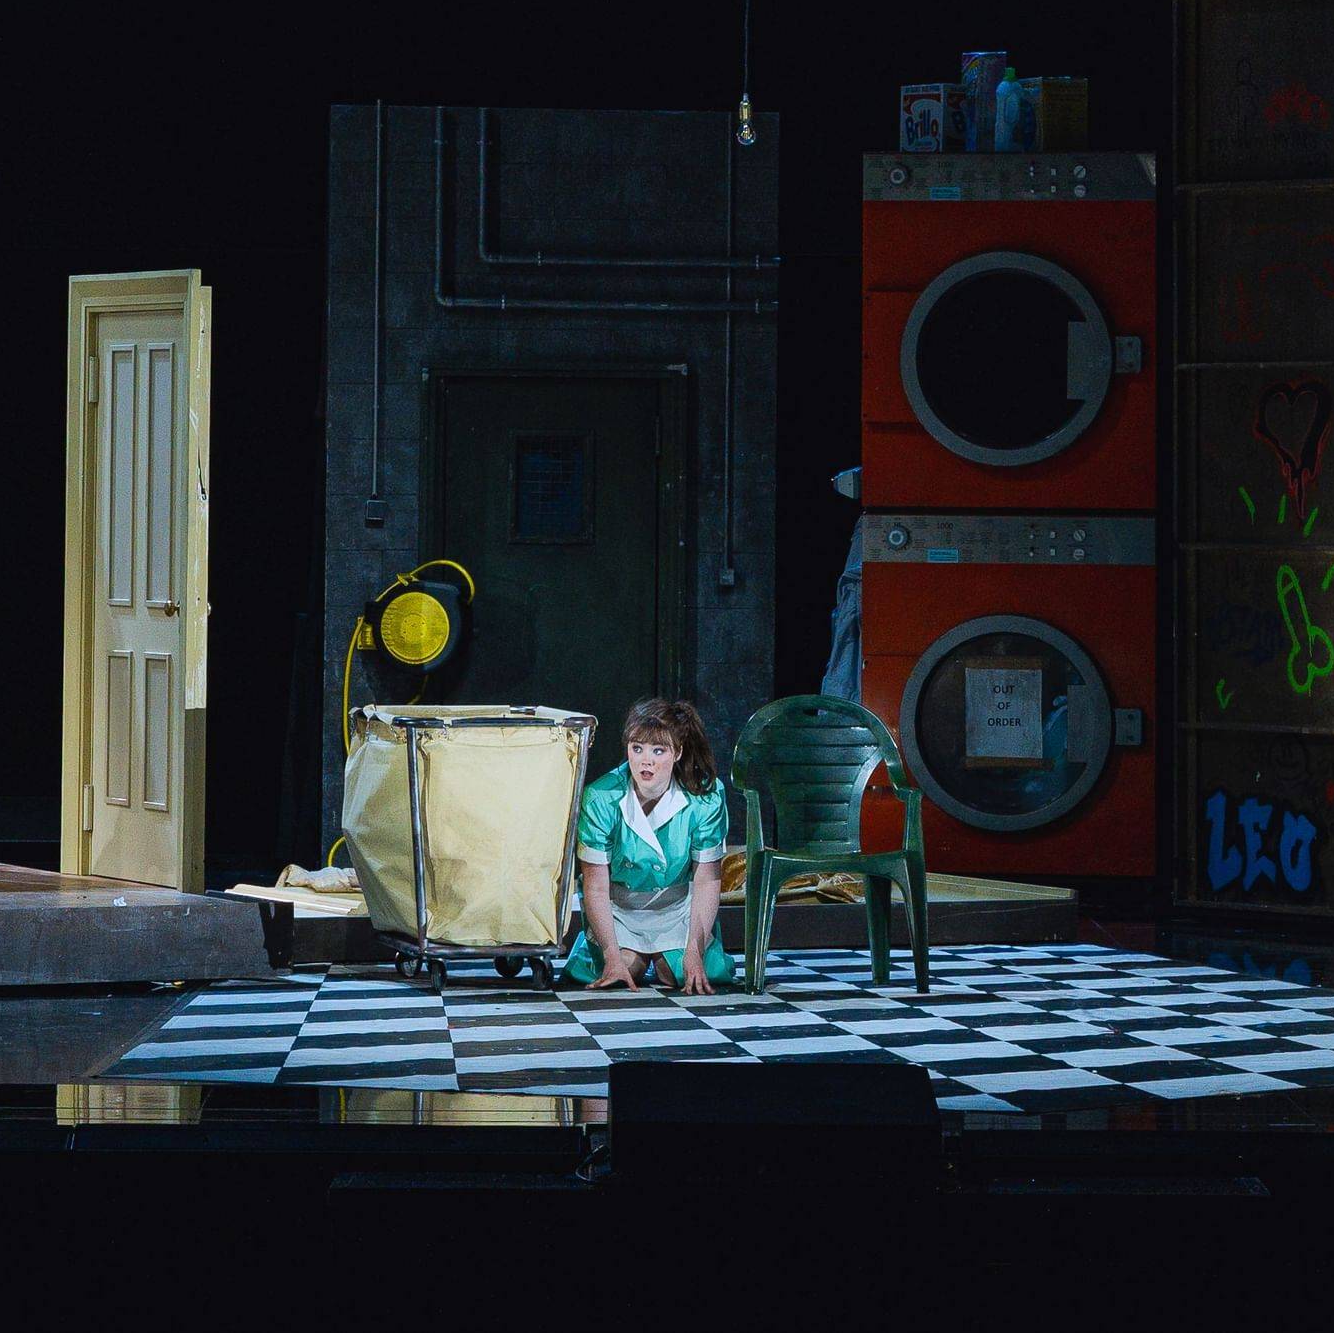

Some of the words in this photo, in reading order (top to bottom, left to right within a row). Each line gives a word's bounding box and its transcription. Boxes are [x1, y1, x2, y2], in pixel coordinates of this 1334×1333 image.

[993, 685, 1015, 694] OUT
[997, 701, 1011, 710] OF
[987, 718, 1021, 727] ORDER
[1205, 788, 1318, 892] LEO
